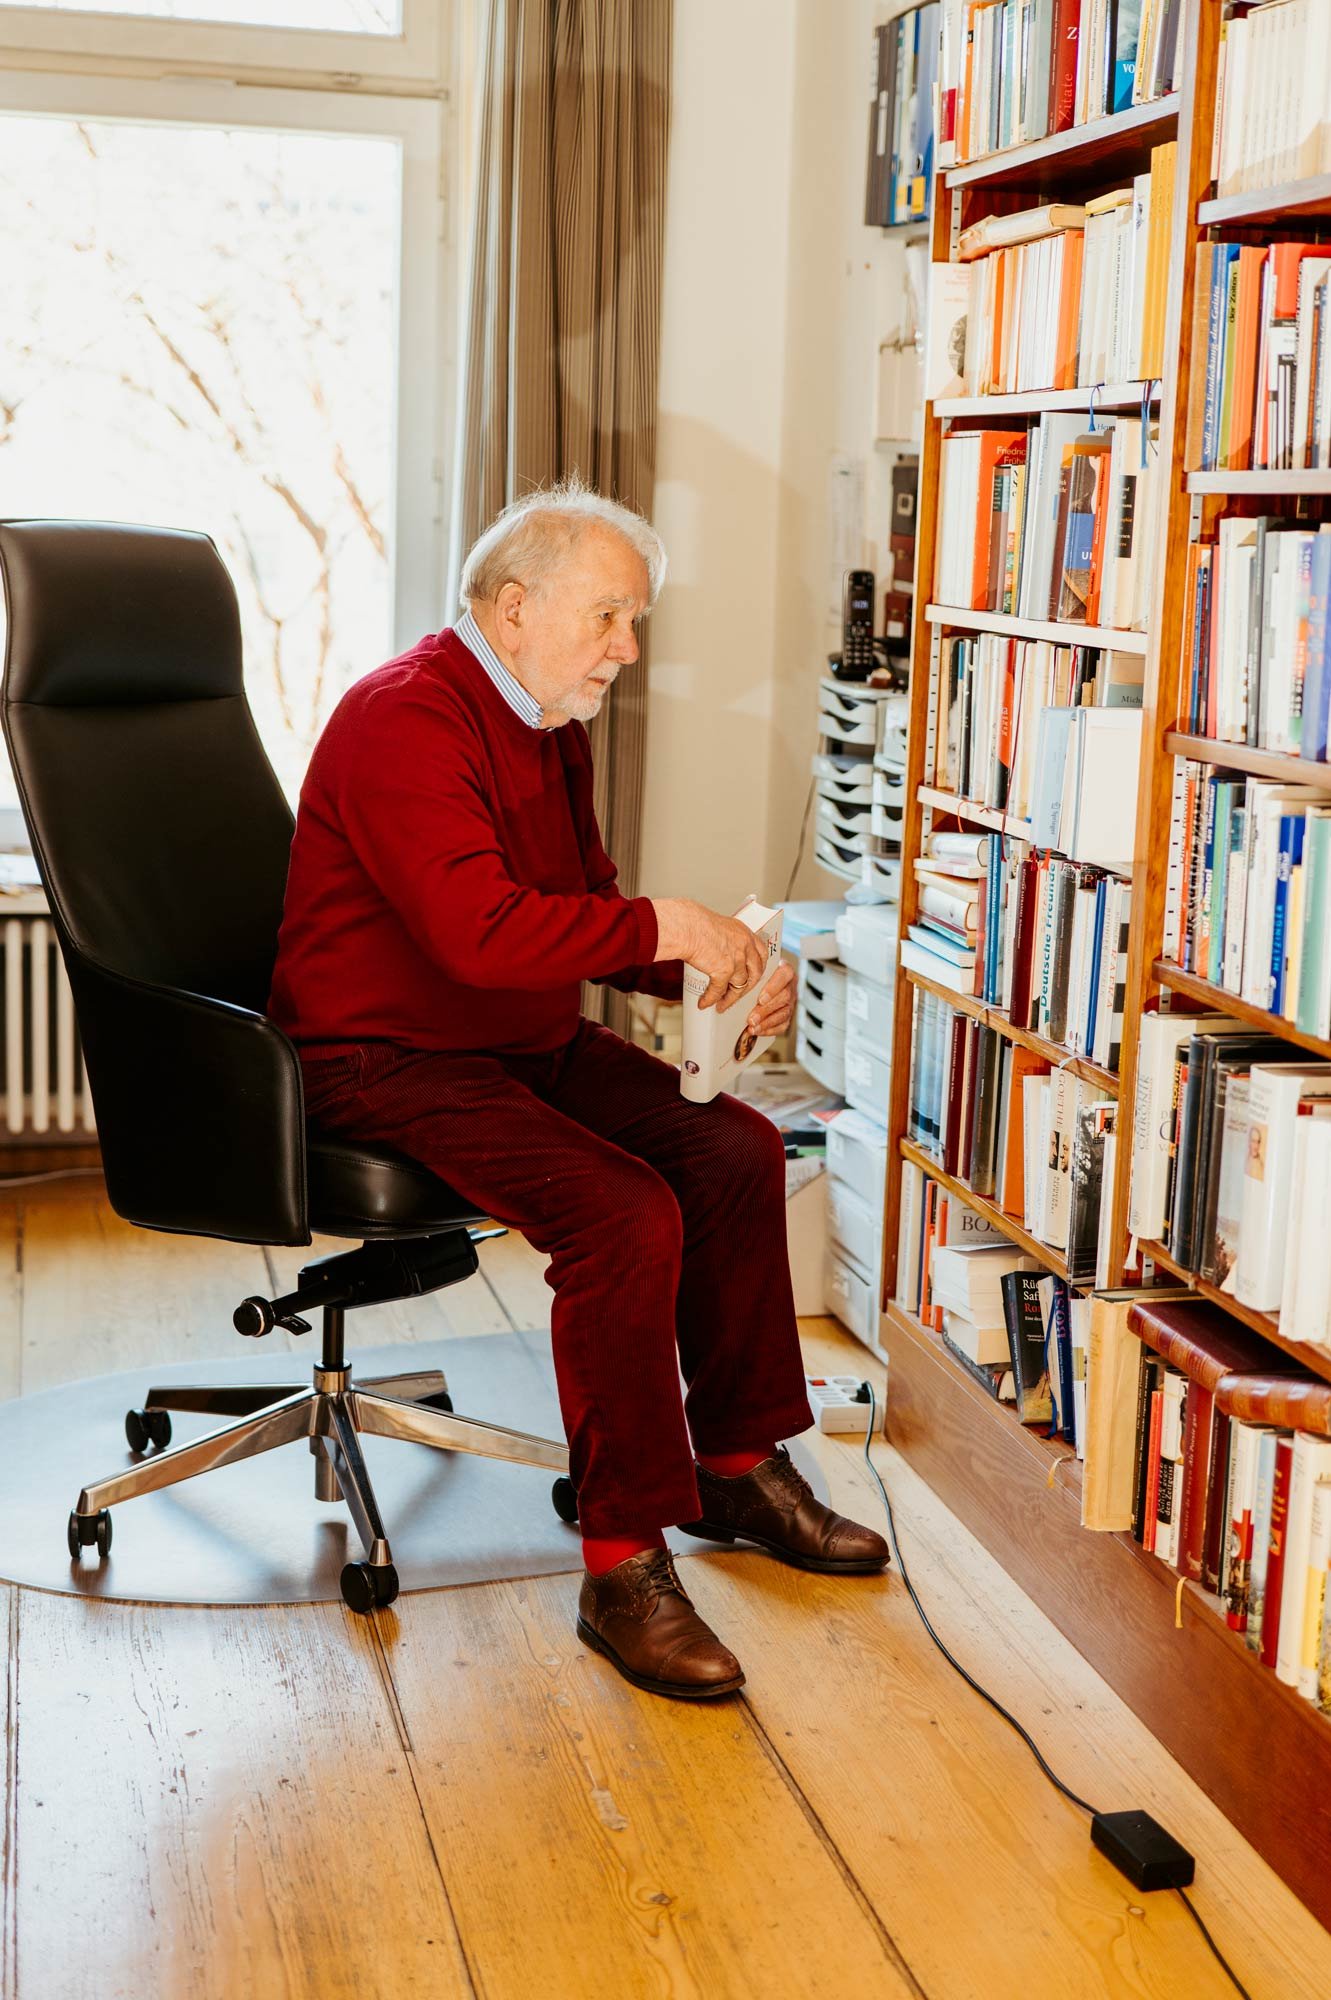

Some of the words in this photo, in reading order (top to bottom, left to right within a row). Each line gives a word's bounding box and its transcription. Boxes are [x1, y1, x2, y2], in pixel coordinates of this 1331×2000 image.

[1058, 73, 1073, 120] Zitate
[1206, 343, 1219, 402] Entdeckung
[1205, 405, 1214, 424] Die
[1050, 810, 1059, 835] Springer
[1202, 868, 1213, 912] einmal
[1040, 934, 1051, 1008] Deutsche
[1046, 864, 1056, 928] Freunde
[1272, 904, 1284, 972] METZINGER
[1165, 1466, 1173, 1499] Zeitgeist
